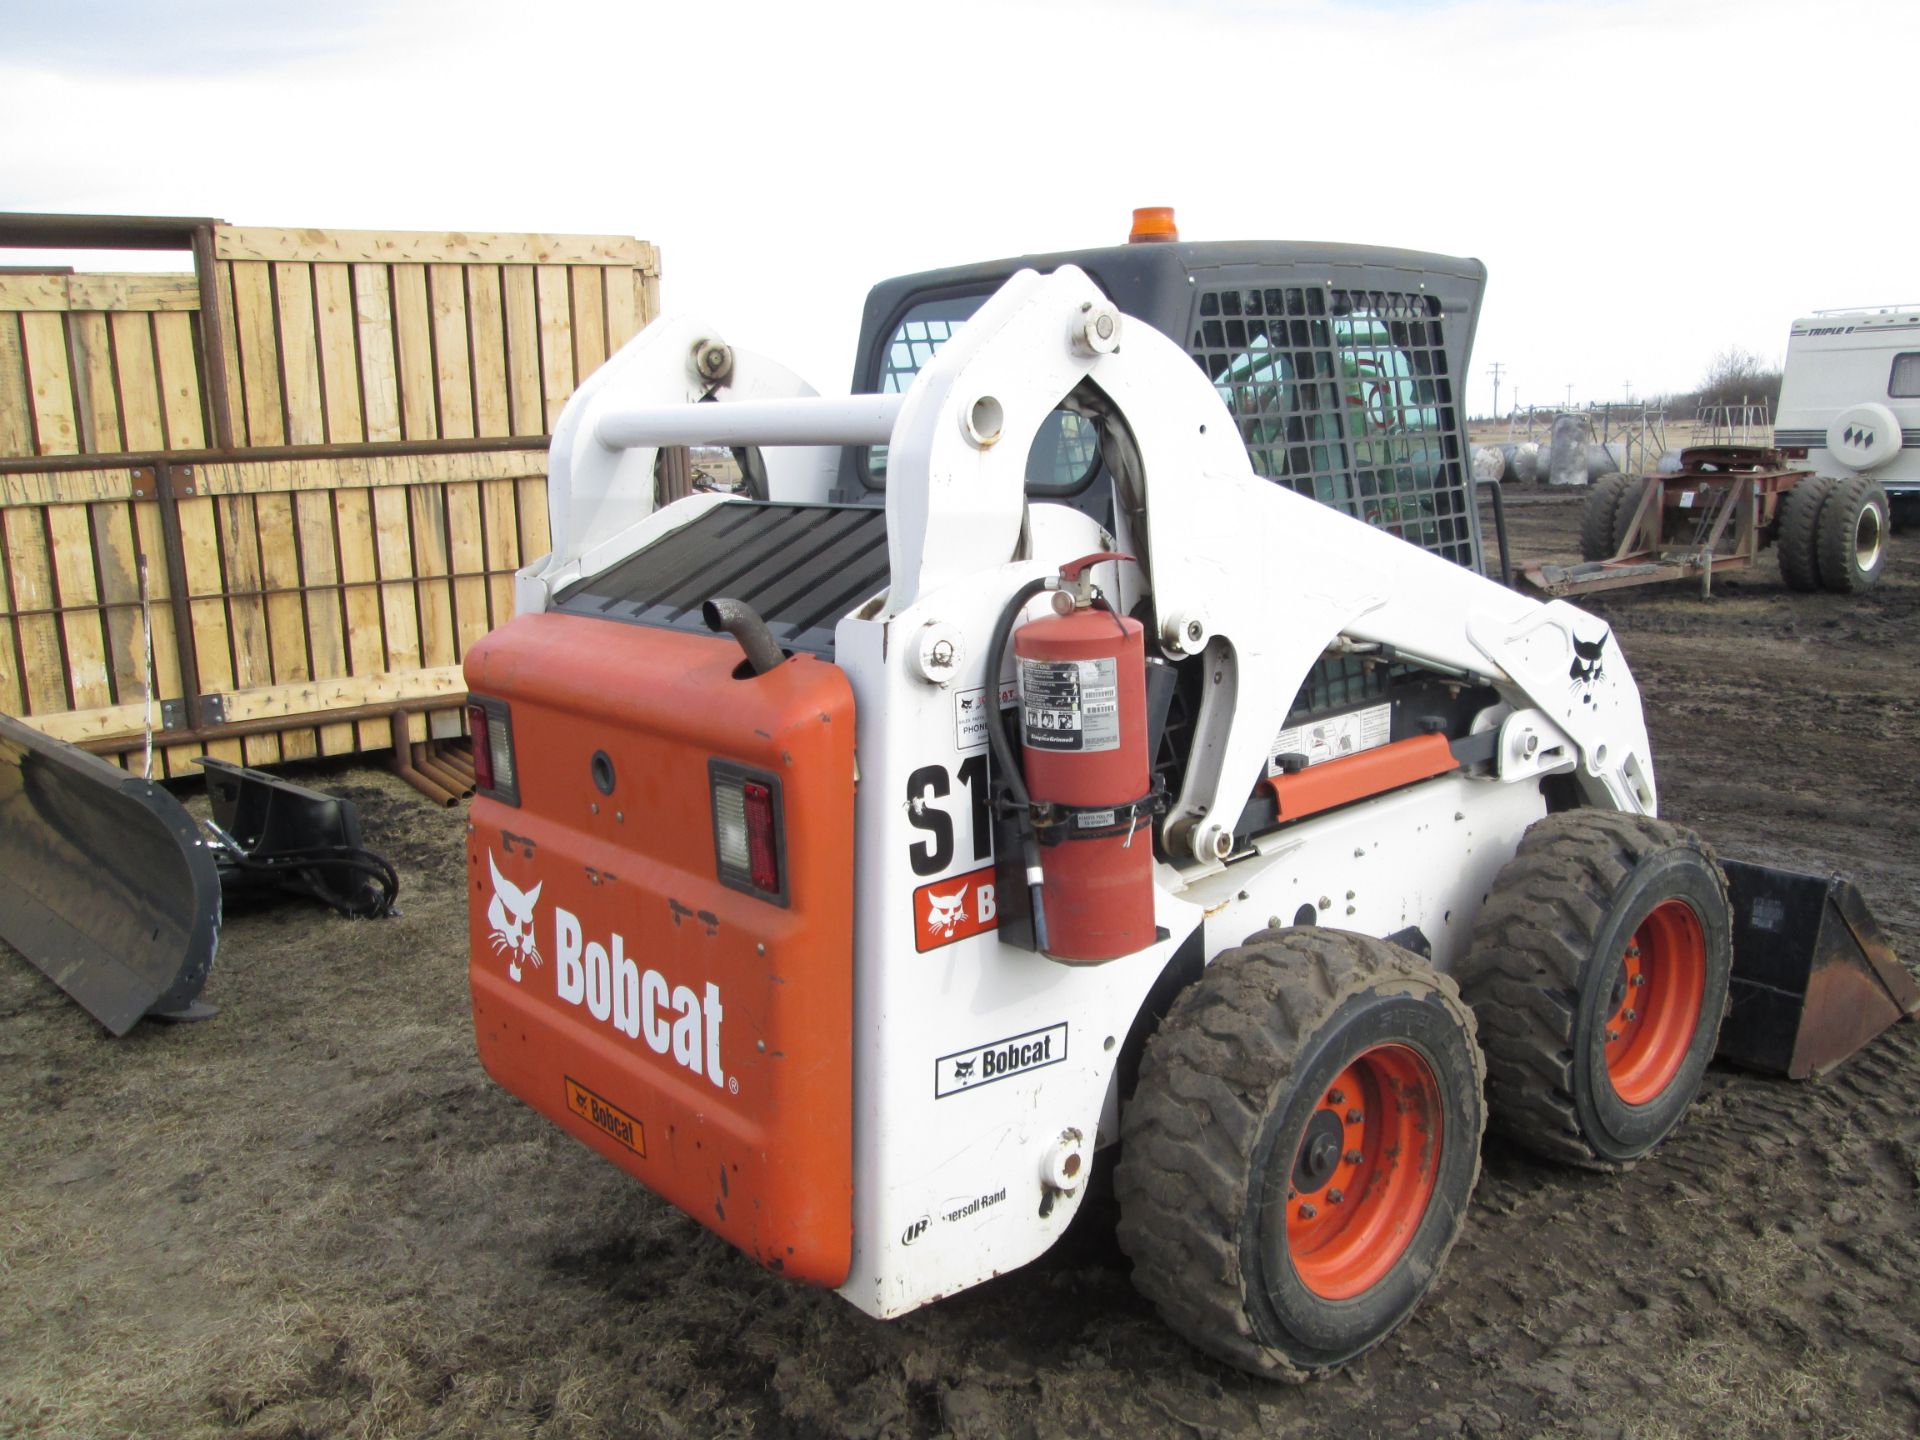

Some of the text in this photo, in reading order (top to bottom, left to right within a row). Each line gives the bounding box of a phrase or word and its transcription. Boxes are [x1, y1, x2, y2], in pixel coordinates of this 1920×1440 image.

[1808, 327, 1844, 337] TRIPLE
[555, 906, 724, 1088] Bobcat
[982, 1034, 1051, 1078] Bobcat
[591, 1097, 635, 1147] Bobcat
